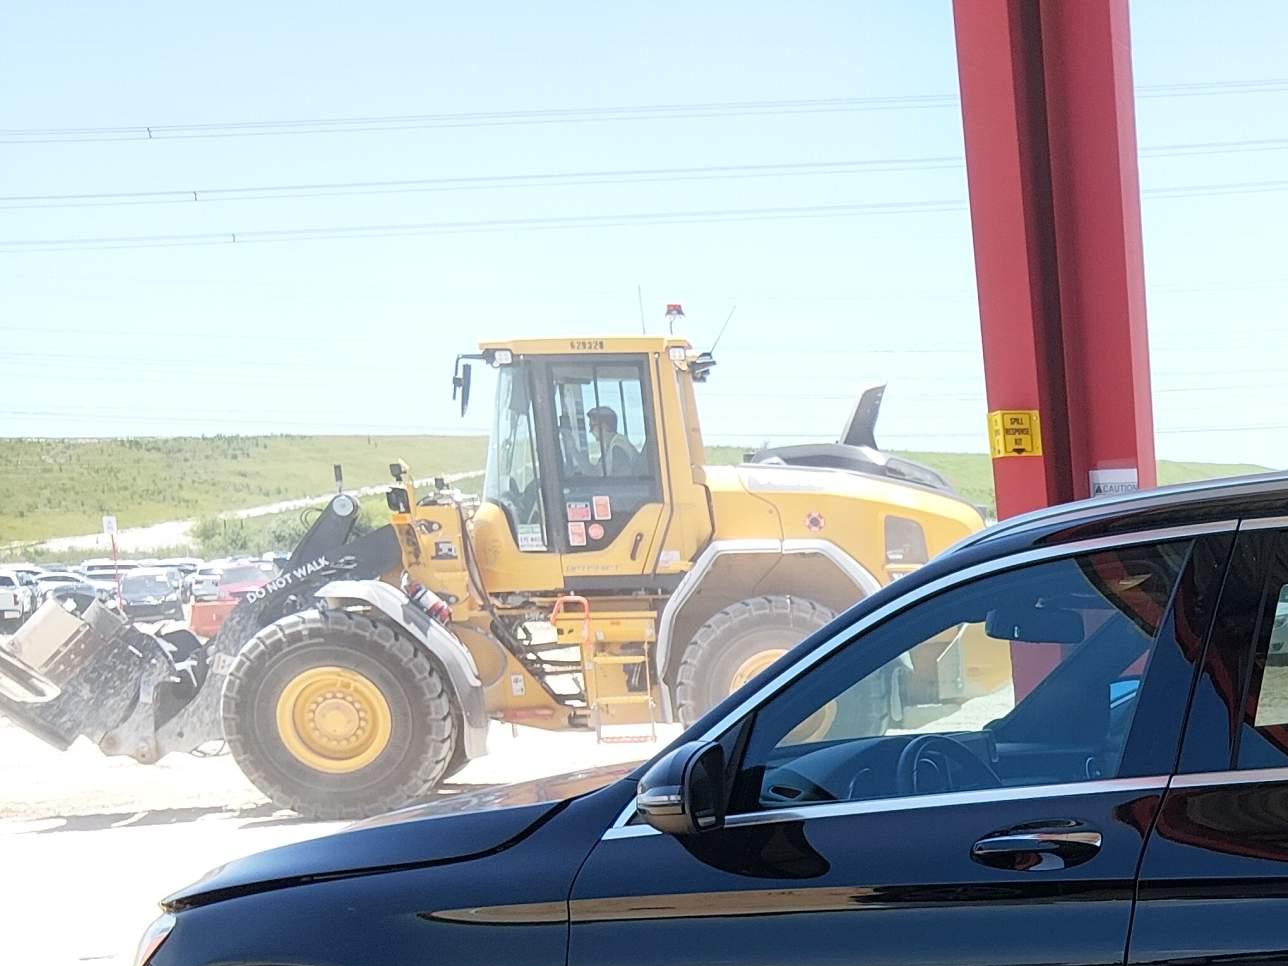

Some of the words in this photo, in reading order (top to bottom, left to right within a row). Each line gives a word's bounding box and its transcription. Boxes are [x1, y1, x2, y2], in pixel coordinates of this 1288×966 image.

[1009, 417, 1024, 425] SPILL
[1005, 427, 1030, 436] RESPONSE
[1014, 438, 1022, 446] KIT
[246, 588, 266, 604] DO
[266, 573, 292, 593] NOT
[292, 555, 329, 578] WALK
